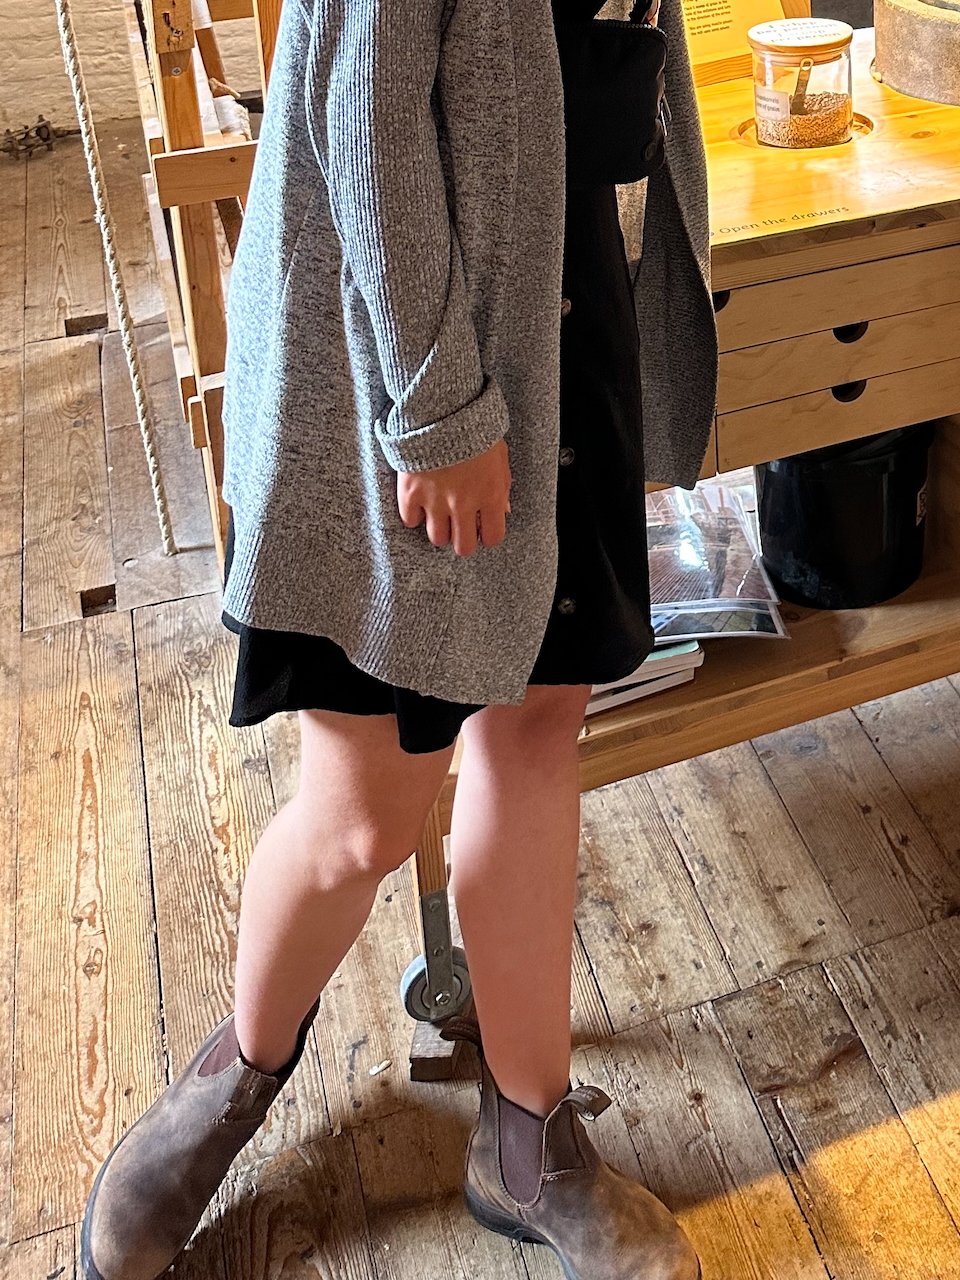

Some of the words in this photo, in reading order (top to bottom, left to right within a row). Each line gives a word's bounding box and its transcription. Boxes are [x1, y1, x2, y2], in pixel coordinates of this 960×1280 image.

[719, 222, 760, 234] Open
[762, 216, 788, 227] the
[791, 206, 850, 221] drawers
